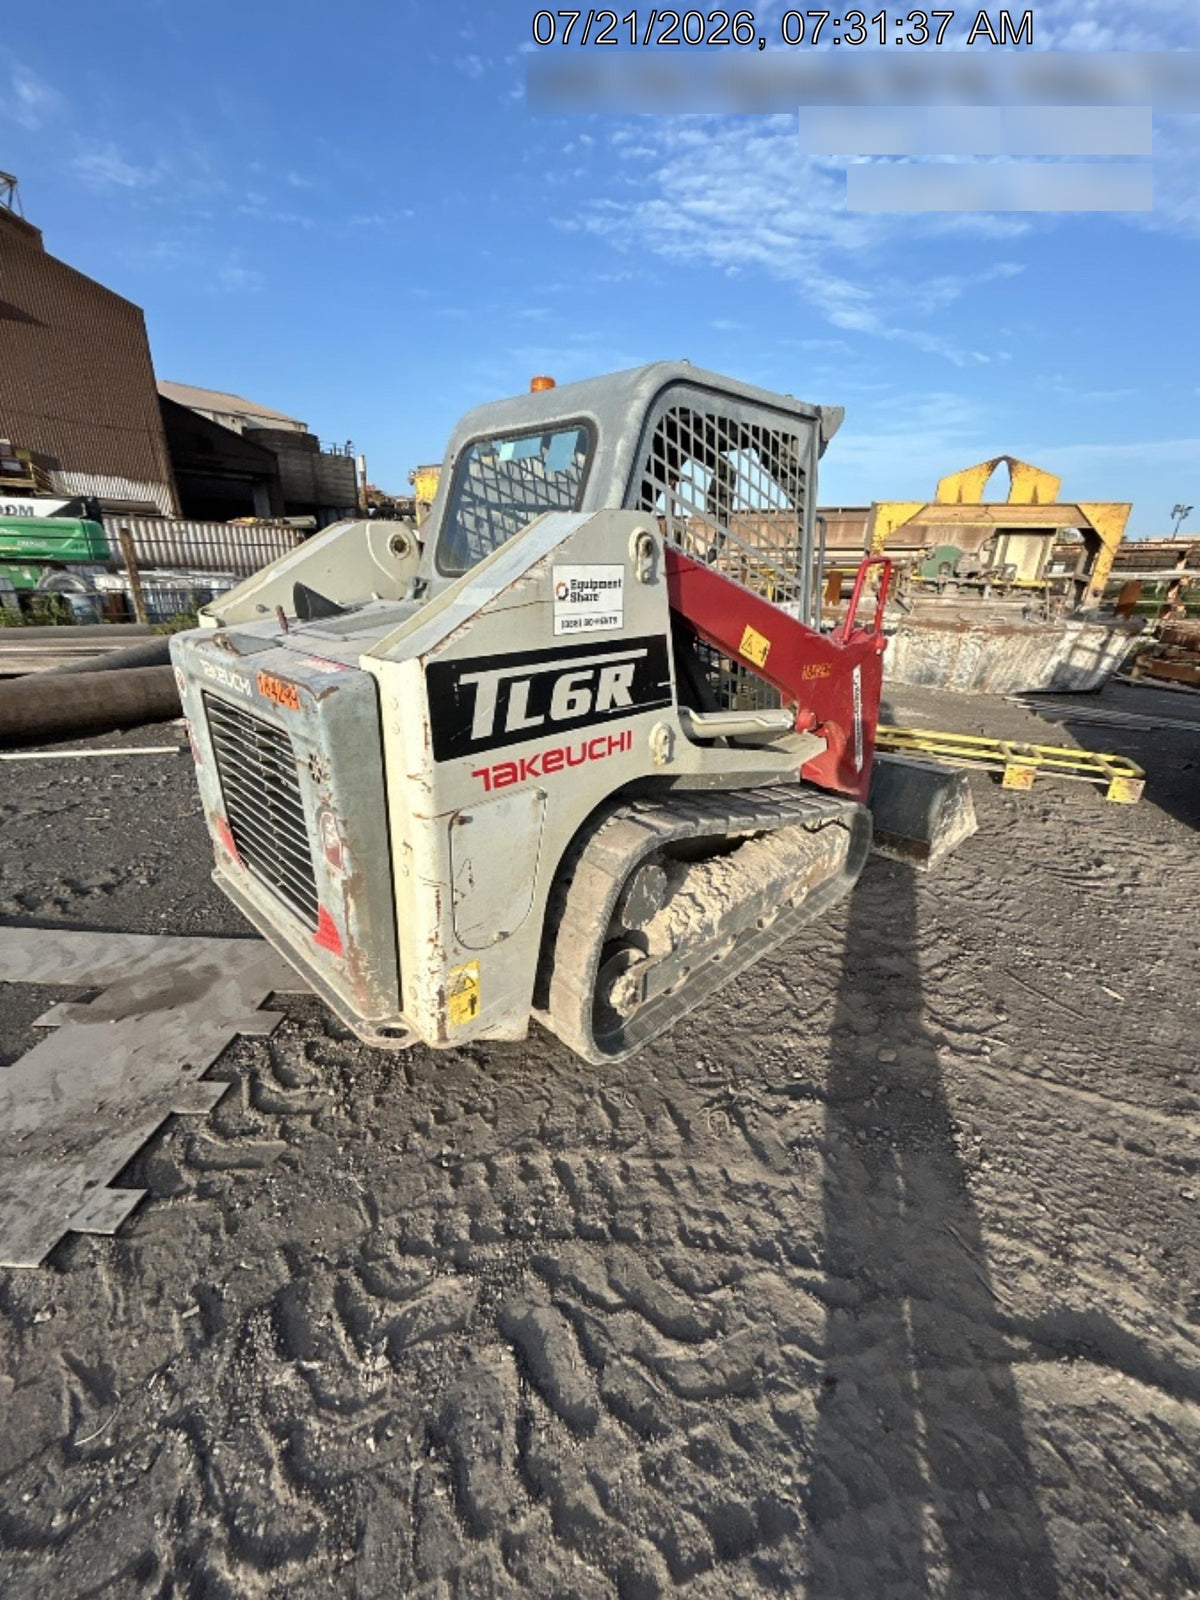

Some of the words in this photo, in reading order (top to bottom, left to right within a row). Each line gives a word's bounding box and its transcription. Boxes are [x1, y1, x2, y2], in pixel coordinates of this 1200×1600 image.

[570, 577, 622, 592] Equipment
[570, 592, 600, 603] Share
[458, 648, 648, 740] TL6R
[471, 730, 632, 792] TAKEUCHI
